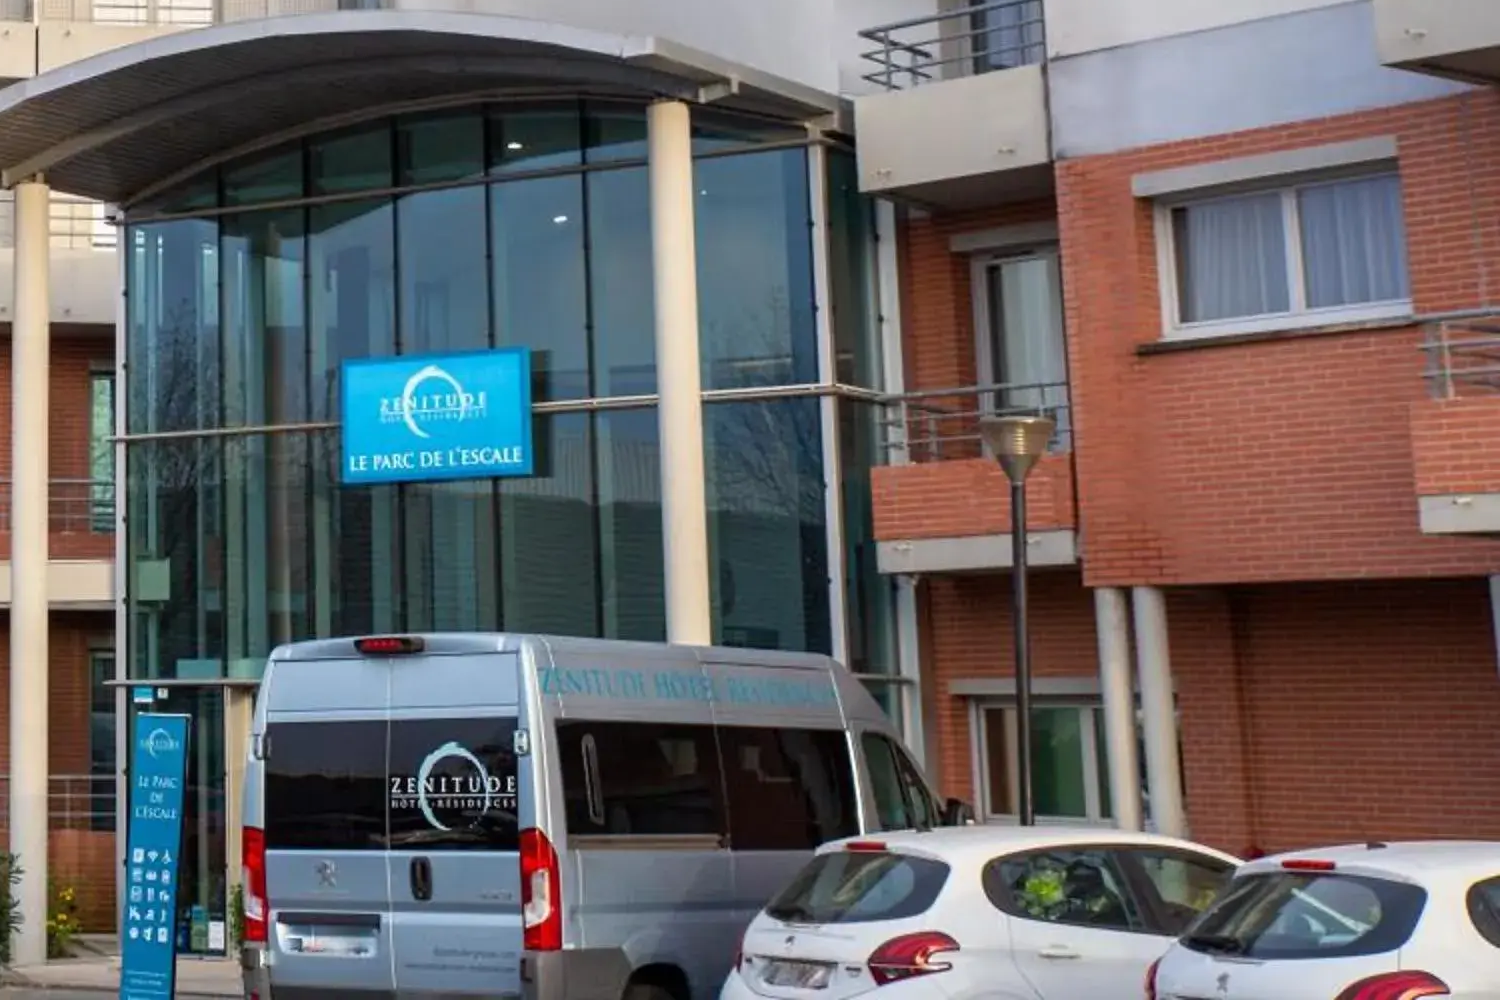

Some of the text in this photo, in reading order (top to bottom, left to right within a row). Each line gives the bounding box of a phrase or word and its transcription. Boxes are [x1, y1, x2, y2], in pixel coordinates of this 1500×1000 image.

[380, 391, 487, 412] ZENITUDE
[350, 445, 523, 471] LE PARC DE L'ESCALE
[538, 667, 647, 698] ZENITUDE
[391, 776, 516, 793] ZENITUDE
